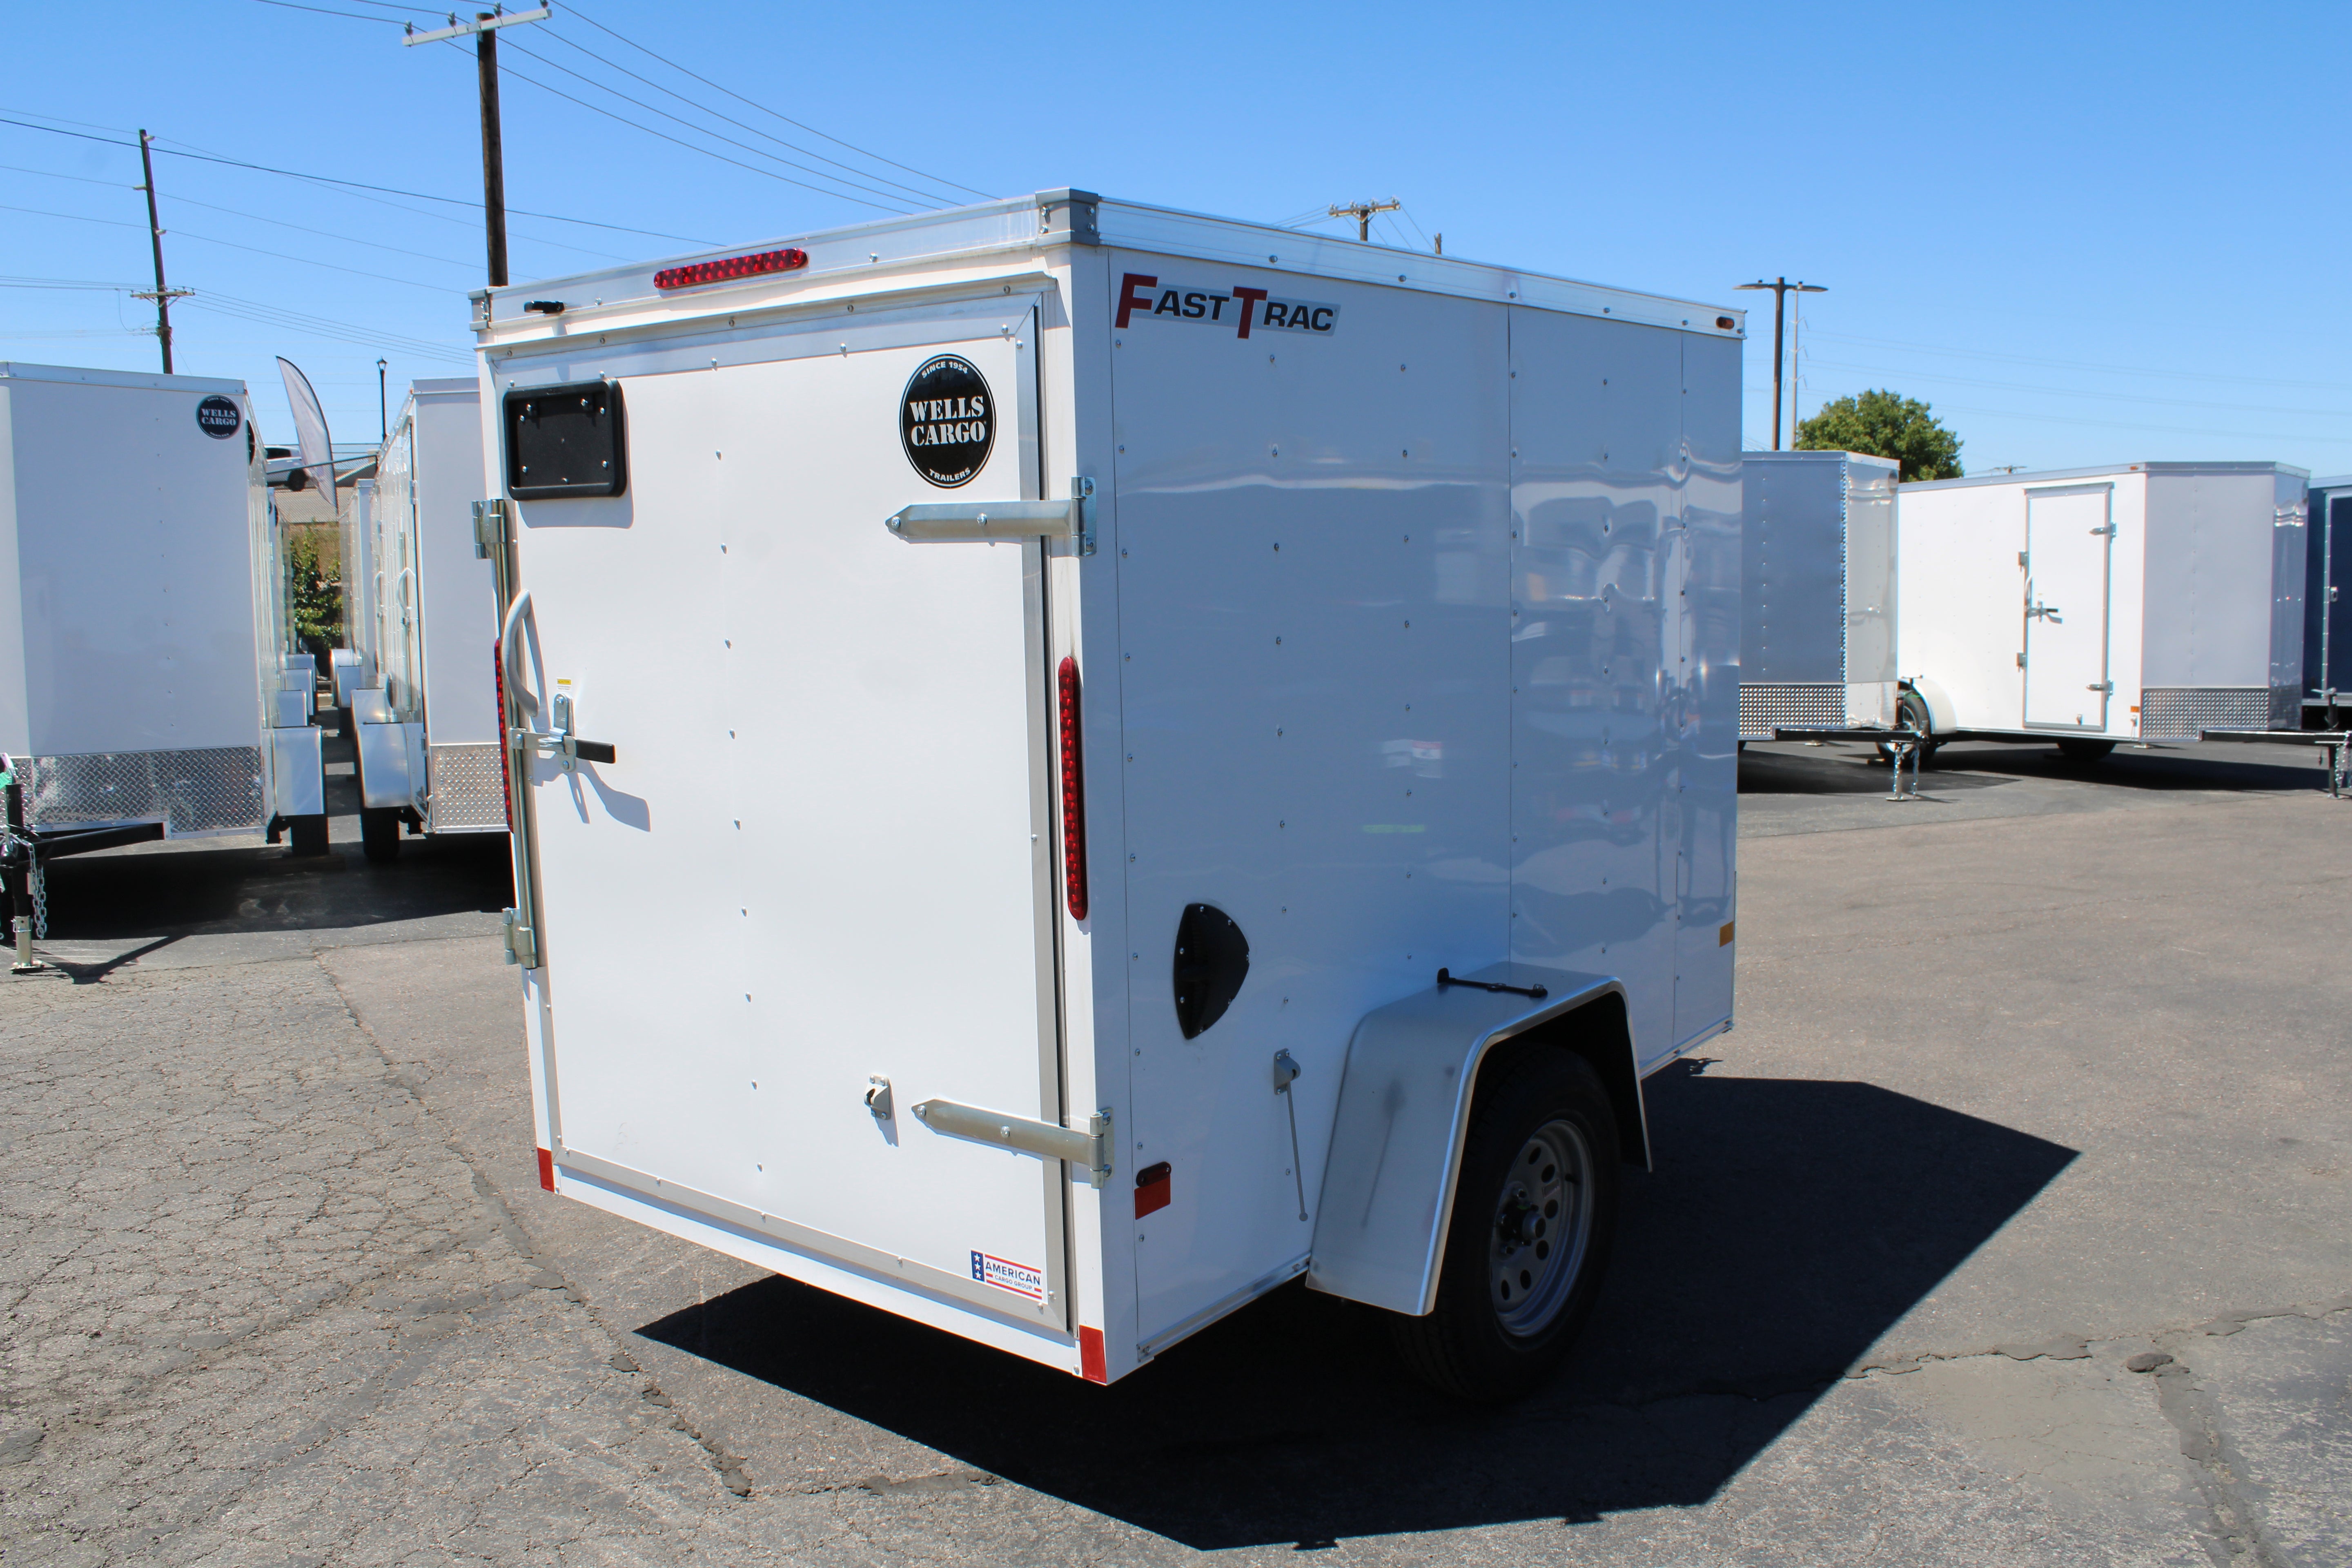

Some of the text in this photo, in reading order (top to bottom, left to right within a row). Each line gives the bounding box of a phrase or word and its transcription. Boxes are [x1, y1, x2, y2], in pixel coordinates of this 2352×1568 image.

[921, 361, 969, 379] SINCE 1954
[201, 408, 236, 418] WELLS
[909, 395, 984, 422] WELLS
[201, 416, 236, 426] CARGO
[911, 421, 986, 446] CARGO
[929, 467, 971, 482] TRAILERS
[985, 1261, 1040, 1285] AMERICAN
[995, 1274, 1032, 1290] CARGO GROUP
